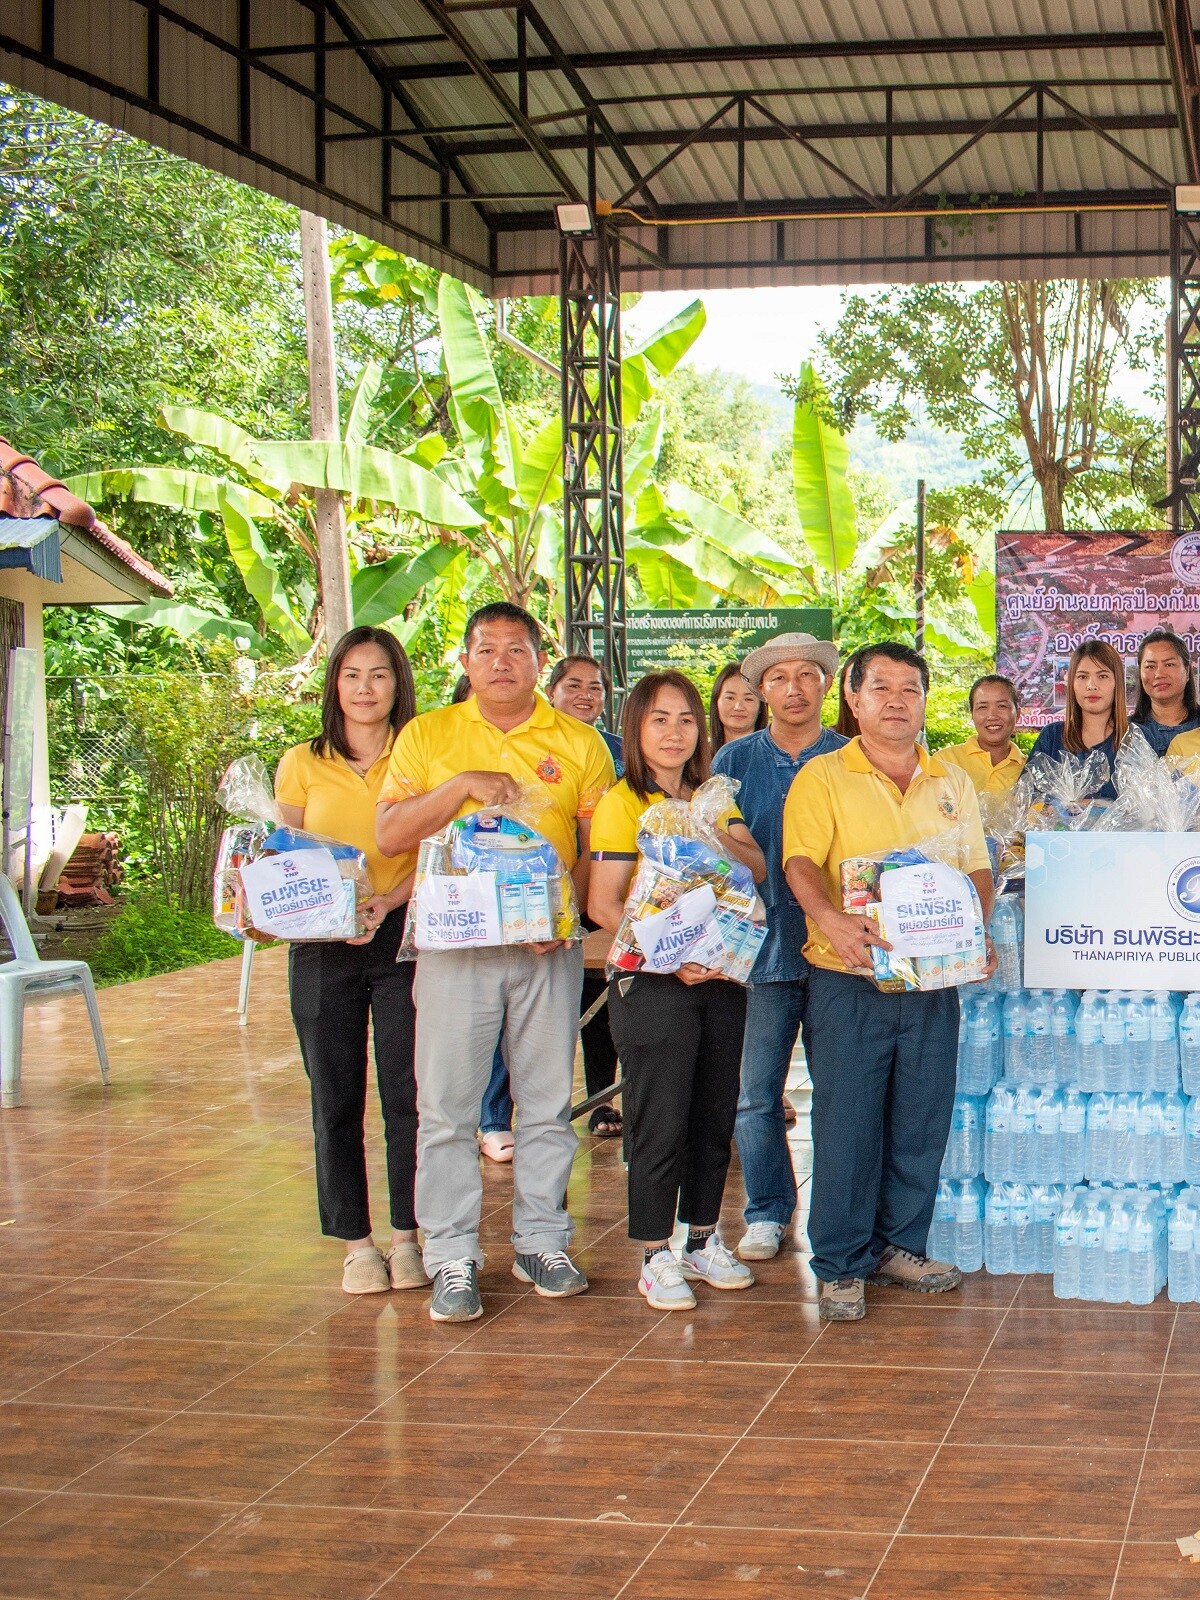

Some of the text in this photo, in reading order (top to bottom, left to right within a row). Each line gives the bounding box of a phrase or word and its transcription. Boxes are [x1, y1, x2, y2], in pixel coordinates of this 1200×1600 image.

[260, 877, 330, 906] ธนพิริยะ
[1045, 925, 1104, 946] บริษัท
[1113, 925, 1200, 946] ธนพิริยะ
[1073, 951, 1155, 962] THANAPIRIYA
